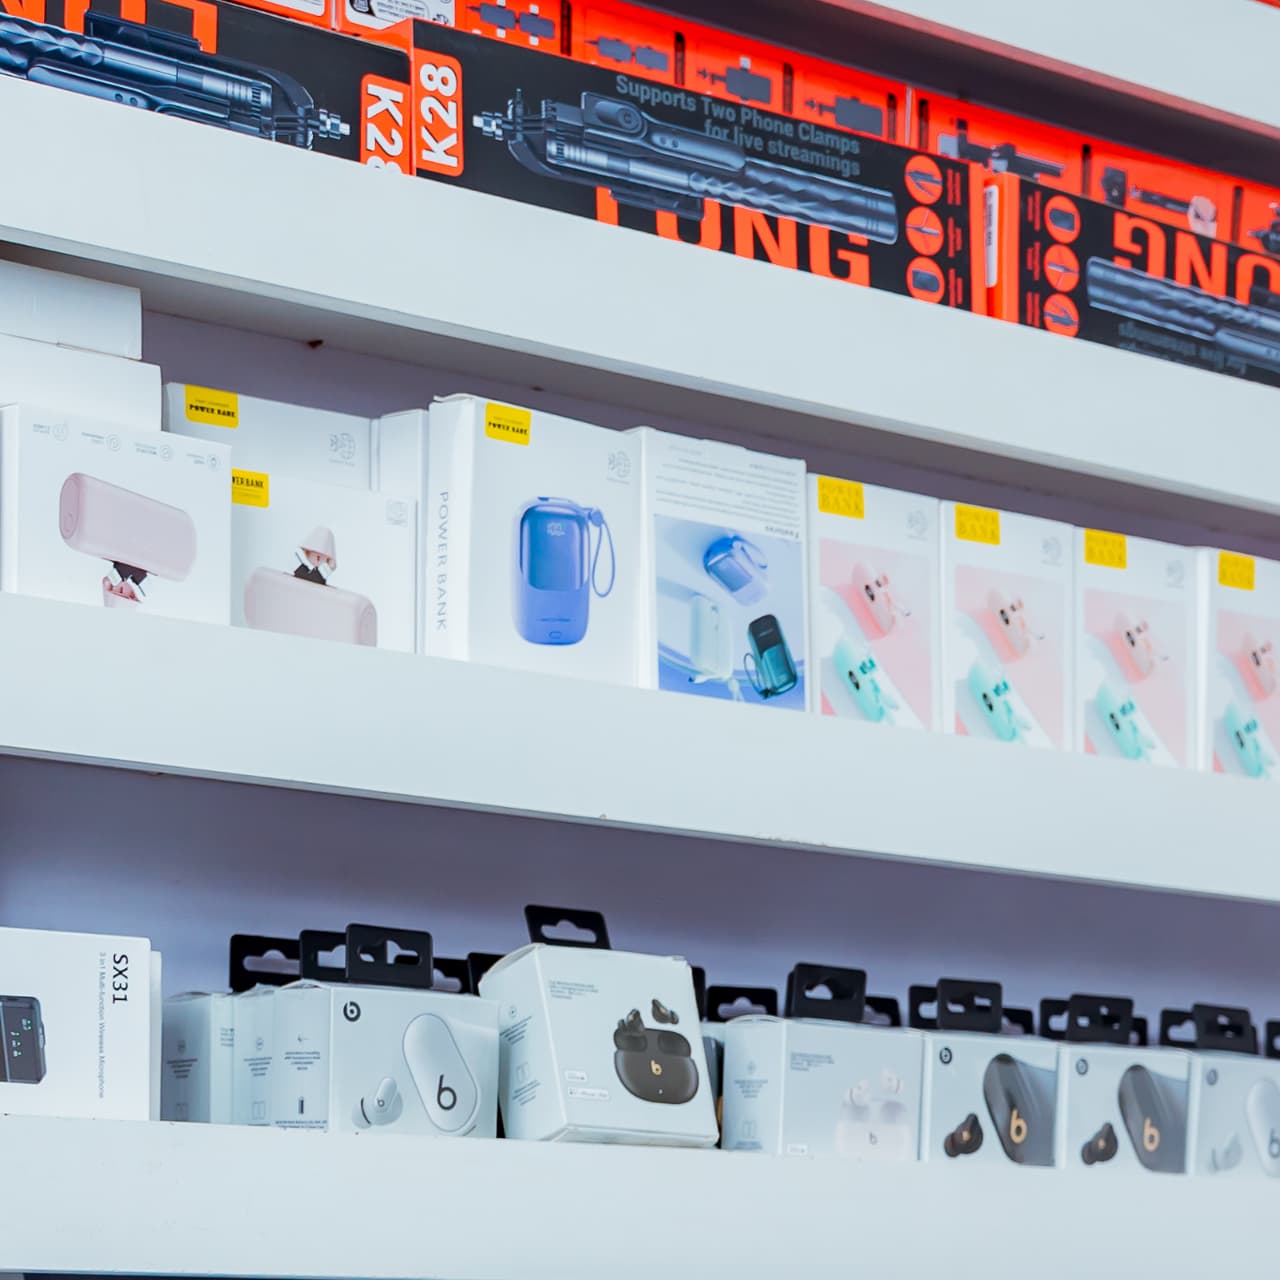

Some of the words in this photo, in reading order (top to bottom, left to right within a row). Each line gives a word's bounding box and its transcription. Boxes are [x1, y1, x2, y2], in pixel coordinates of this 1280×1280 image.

[419, 62, 458, 169] K28
[615, 74, 697, 113] Supports
[701, 96, 737, 122] Two
[740, 106, 794, 138] Phone
[798, 122, 861, 155] Clamps
[703, 117, 731, 141] for
[733, 123, 765, 153] live
[768, 137, 861, 178] streamings
[437, 491, 448, 568] POWER
[436, 573, 448, 632] BANK
[113, 953, 129, 1004] SX31
